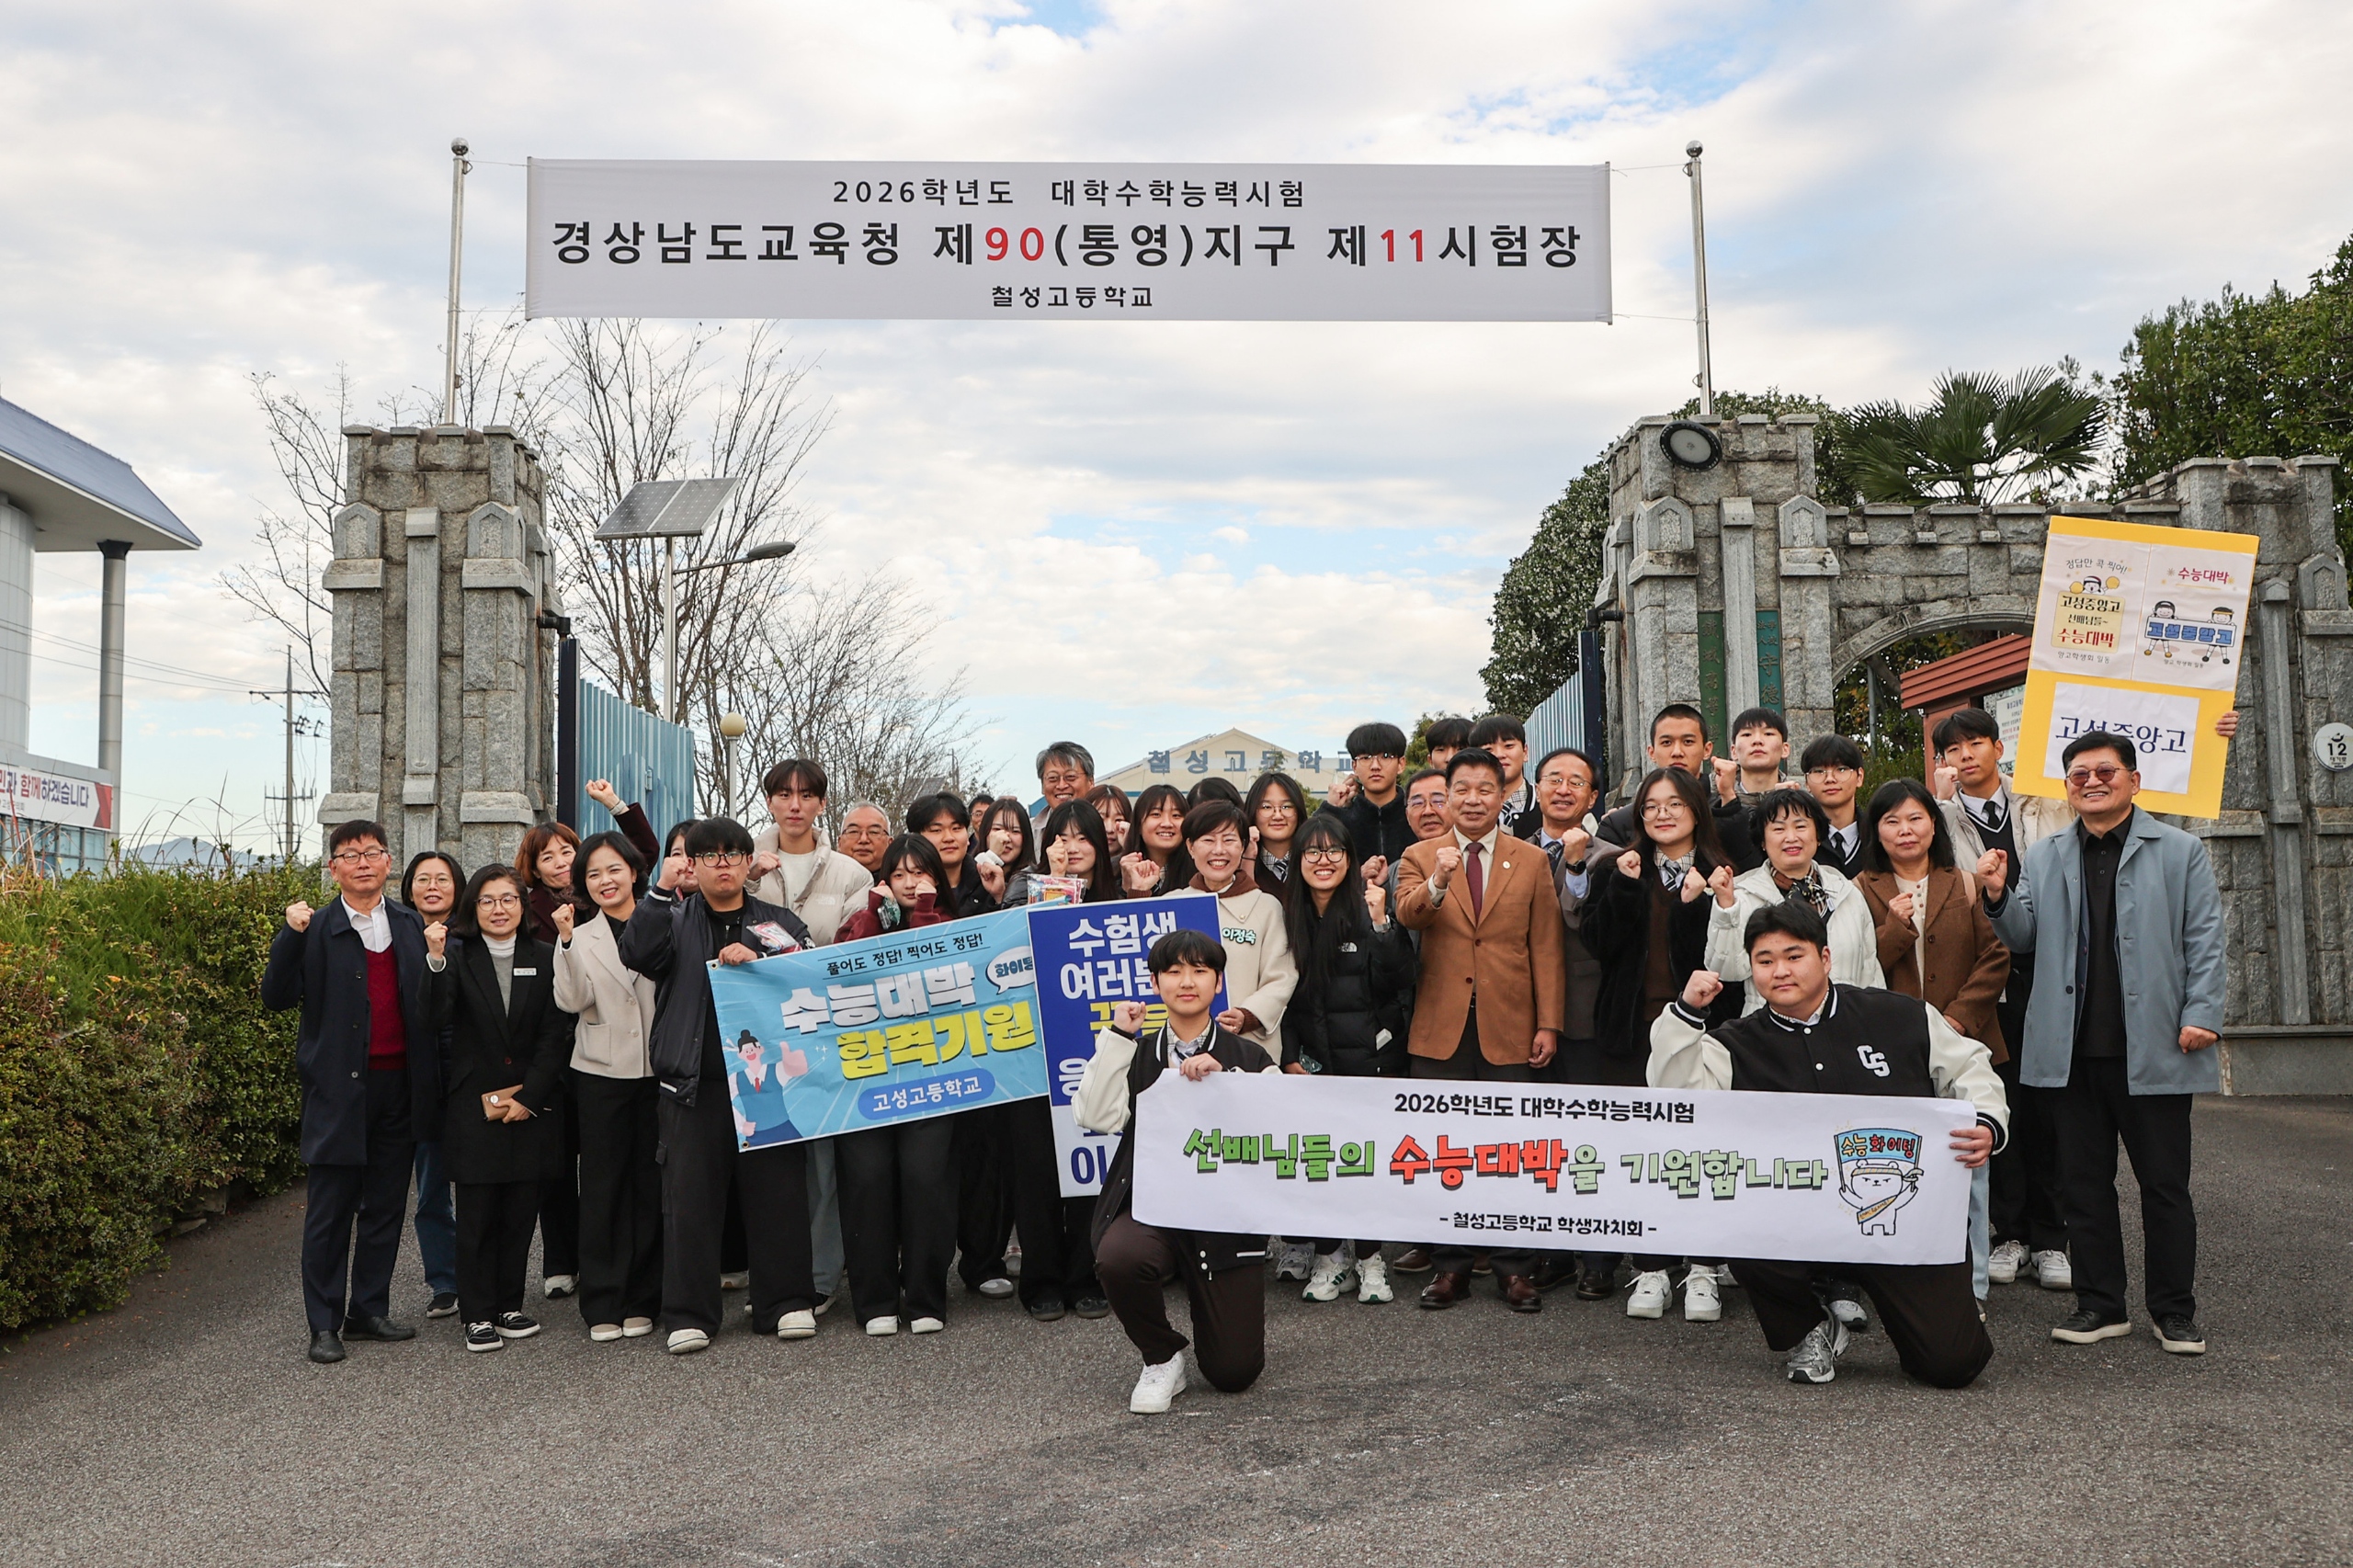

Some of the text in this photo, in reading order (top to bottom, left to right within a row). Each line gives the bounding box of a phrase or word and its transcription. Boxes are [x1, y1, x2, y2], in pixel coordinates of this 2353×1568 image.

[833, 178, 1303, 209] 2026학년도 대학수학능력시험
[552, 221, 1582, 267] 경상남도교육청 제90(통영)지구 제11시험장
[992, 285, 1153, 309] 철성고등학교
[2066, 558, 2093, 570] 정답만
[2177, 567, 2230, 585] 수능대박
[2060, 595, 2120, 614] 고성중앙고
[2057, 628, 2115, 648] 수능대박
[2146, 621, 2233, 645] 고성중앙고
[2327, 743, 2347, 756] 12
[21, 774, 89, 808] 함께하겠습니다
[1222, 927, 1256, 945] 이정숙
[826, 933, 984, 976] 풀어도 정답! 찍어도 정답!
[780, 960, 976, 1035] 수능대박
[837, 1001, 1037, 1081] 합격기원
[872, 1075, 983, 1113] 고성고등학교
[1394, 1093, 1695, 1123] 2026학년도 대학수학능력시험
[1183, 1129, 1829, 1200] 선배님들의 수능대박을 기원합니다
[1453, 1212, 1552, 1233] 철성고등학교
[1557, 1216, 1643, 1237] 학생자치회
